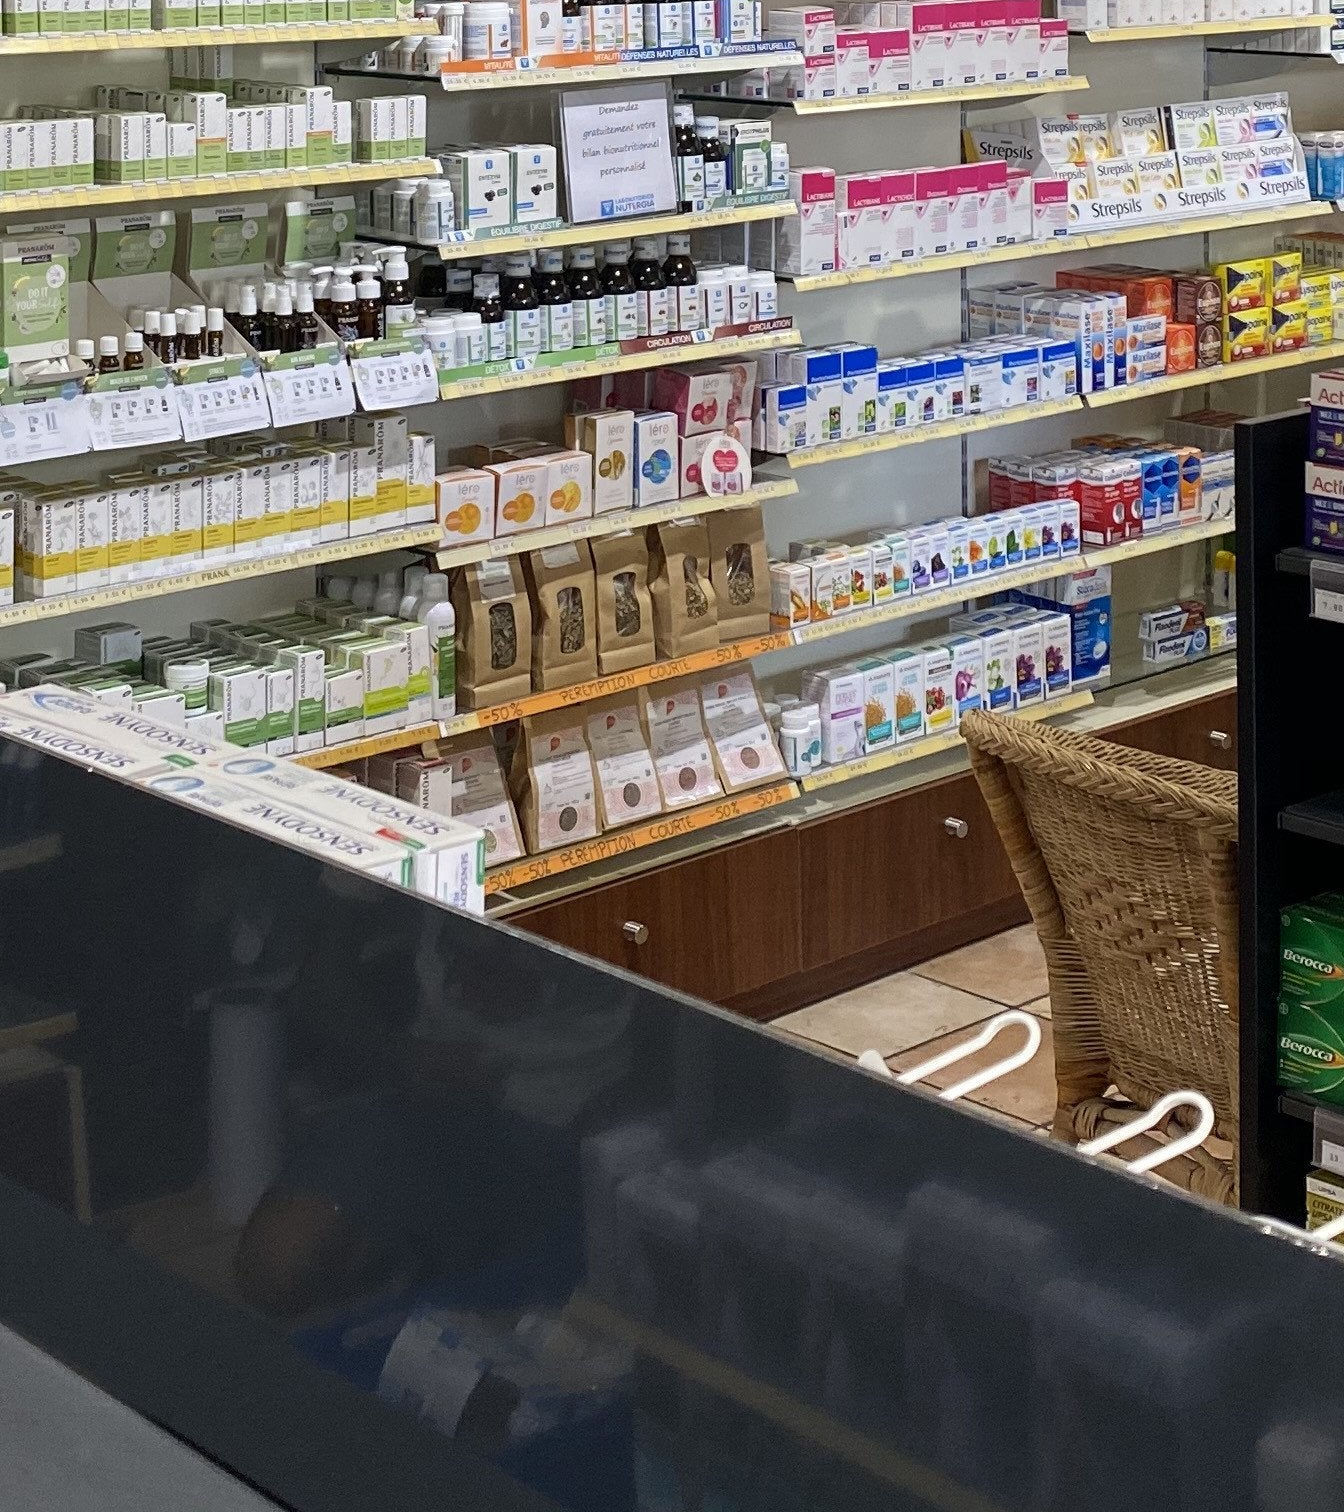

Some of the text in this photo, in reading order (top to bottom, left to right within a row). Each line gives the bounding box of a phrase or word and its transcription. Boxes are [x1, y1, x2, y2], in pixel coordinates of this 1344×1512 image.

[657, 46, 699, 58] NATURELLES
[756, 40, 797, 51] NATURELLES
[598, 102, 639, 116] Demandez
[1175, 107, 1210, 120] Strepsils
[1215, 103, 1249, 116] Strepsils
[1041, 120, 1078, 134] Strepsils
[1122, 114, 1157, 127] Strepsils
[582, 120, 656, 140] gratuitement votre
[582, 145, 601, 157] bilan
[979, 141, 1033, 160] Strepsils
[600, 161, 646, 178] personnalisé
[1260, 176, 1306, 196] Strepsils
[1178, 188, 1226, 206] Strepsils
[1091, 199, 1143, 219] Strepsils
[748, 319, 791, 332] CIRCULATION
[646, 336, 692, 348] CIRCULATION
[484, 702, 525, 721] -50%
[648, 659, 691, 680] COURTE
[1283, 949, 1333, 975] Berocca
[1280, 1035, 1333, 1062] Berocca
